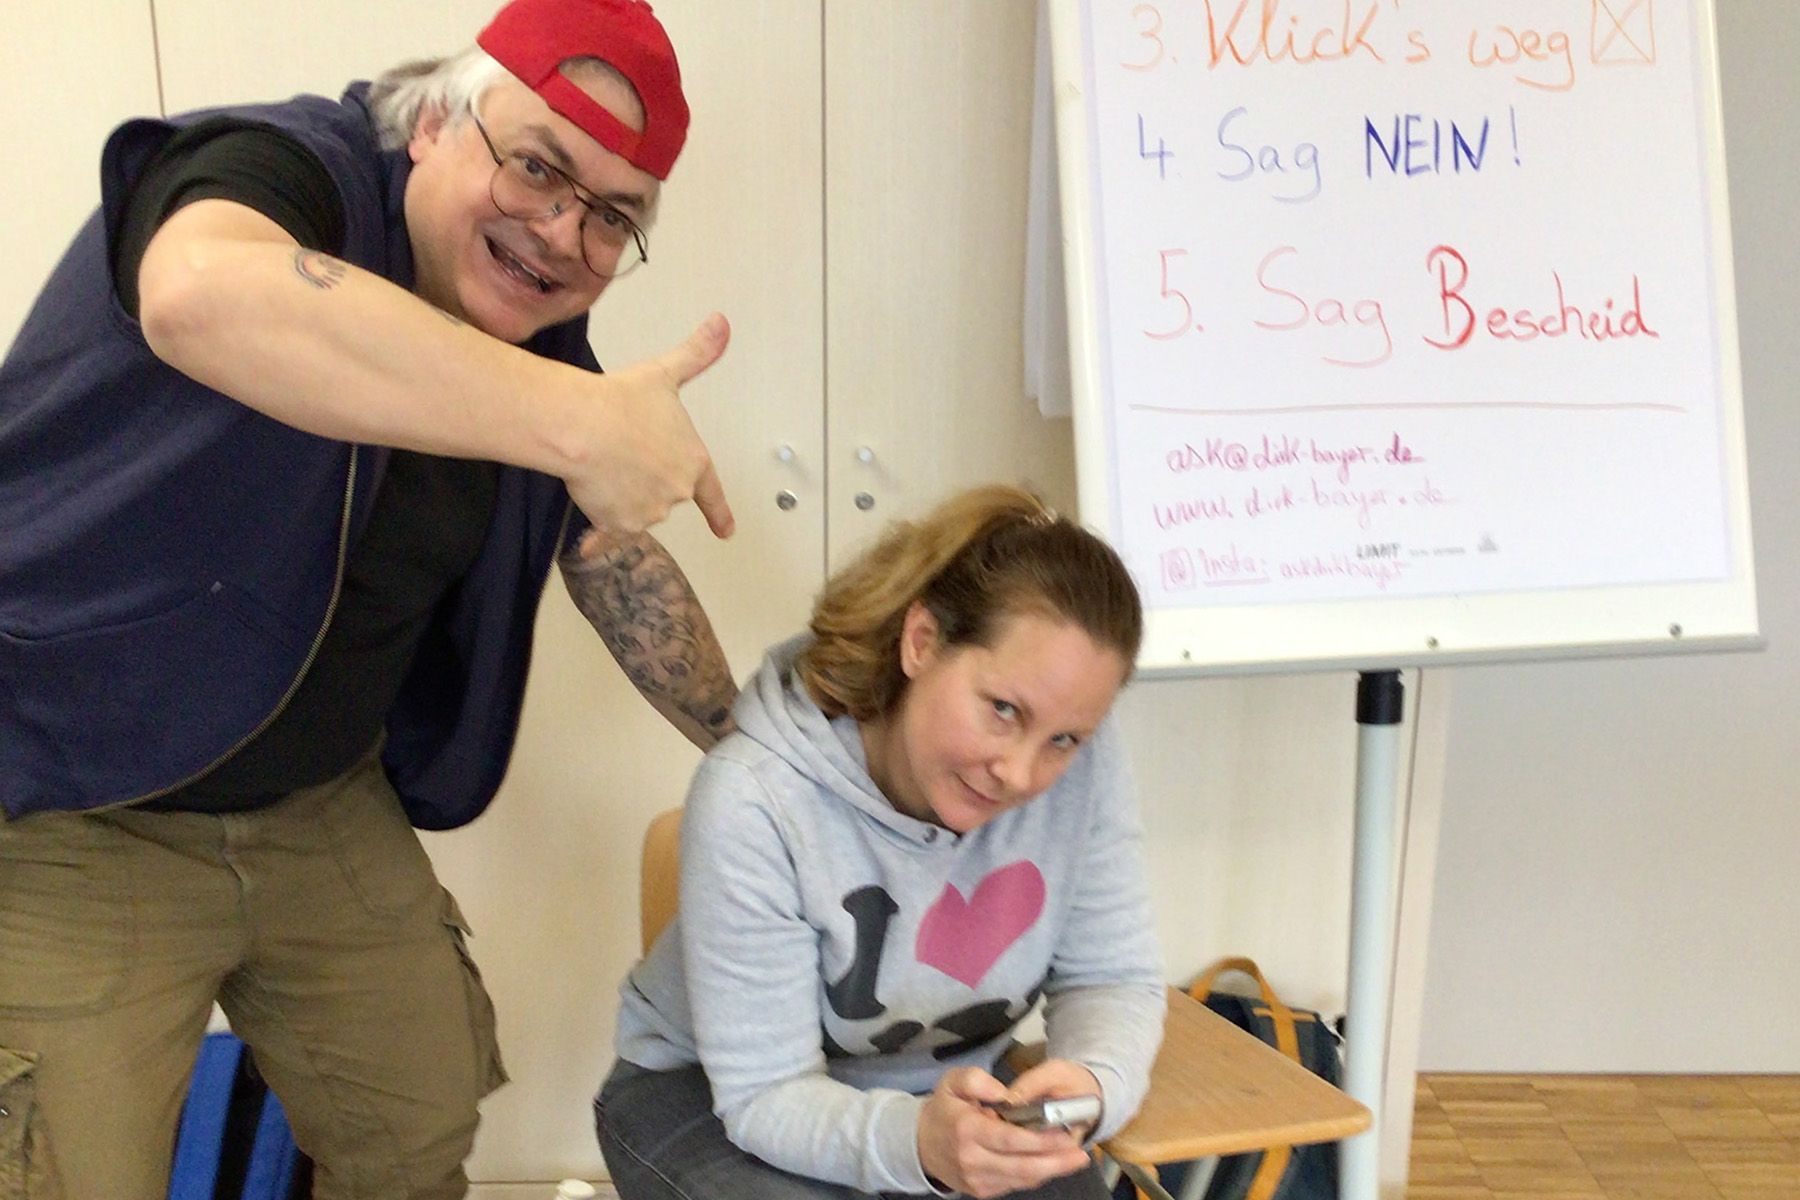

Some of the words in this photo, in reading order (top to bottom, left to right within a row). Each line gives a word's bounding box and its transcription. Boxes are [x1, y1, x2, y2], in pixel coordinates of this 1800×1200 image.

[1119, 3, 1178, 72] 3.
[1468, 24, 1576, 93] weg
[1216, 106, 1322, 204] Sag
[1143, 247, 1204, 341] 5.
[1254, 245, 1393, 368] Sag
[1422, 244, 1660, 350] Bescheid
